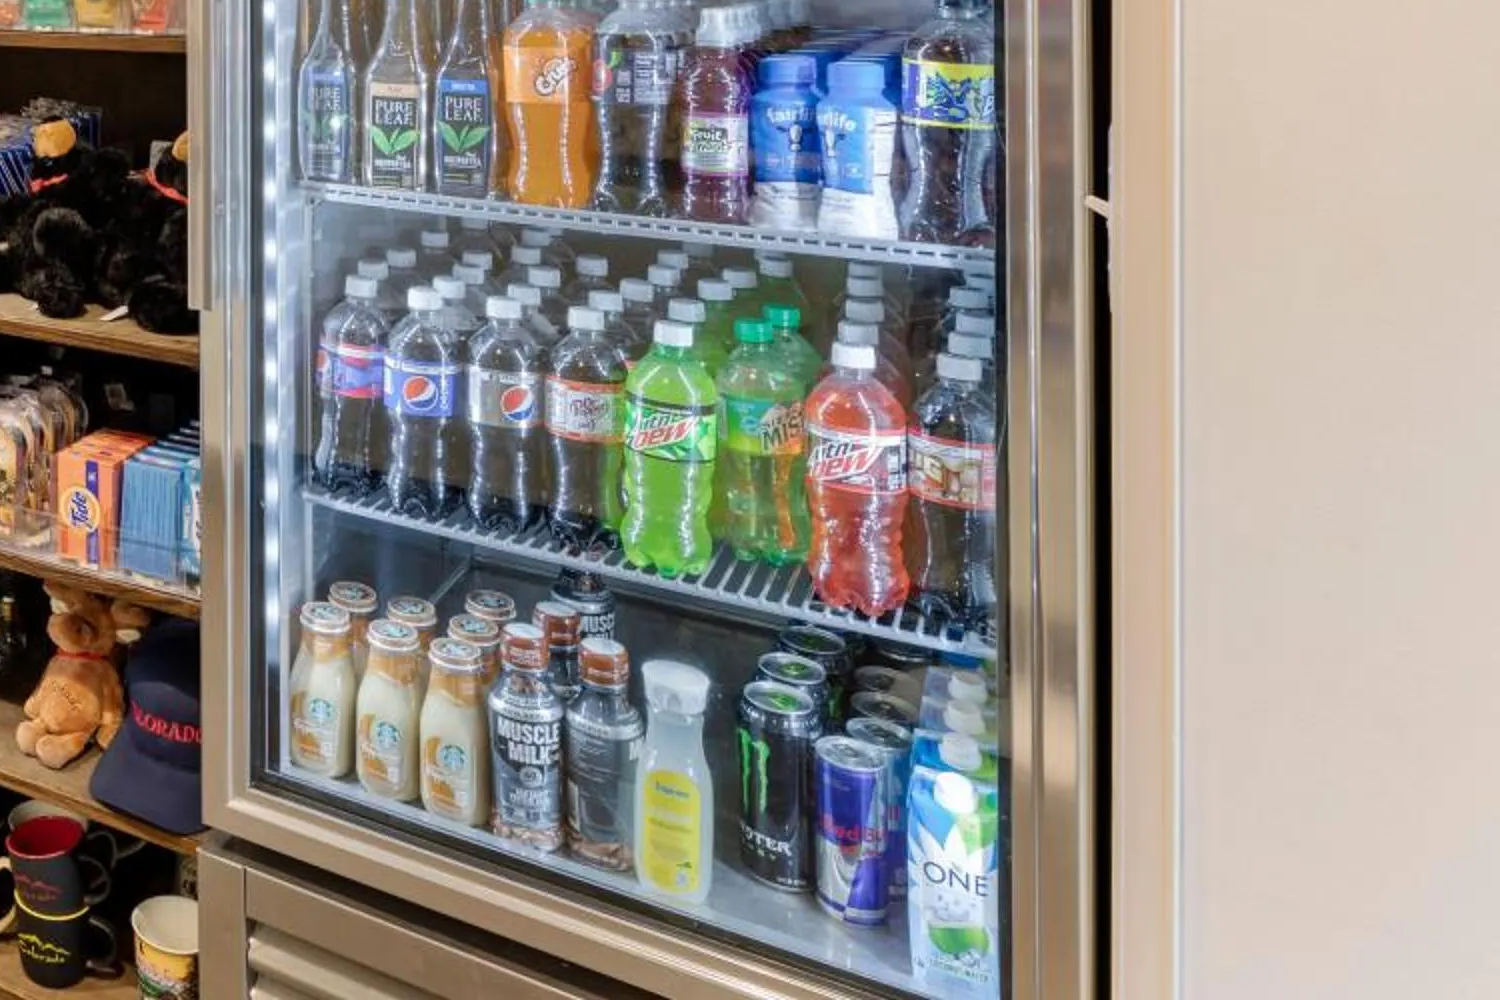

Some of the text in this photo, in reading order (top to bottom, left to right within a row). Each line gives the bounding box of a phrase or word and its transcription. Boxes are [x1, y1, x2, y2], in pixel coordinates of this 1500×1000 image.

[375, 100, 414, 113] PURE
[445, 96, 484, 109] PURE
[375, 112, 414, 126] LEAF
[445, 109, 484, 122] LEAF
[691, 128, 723, 142] Fruit
[70, 491, 90, 528] Tide
[498, 715, 560, 745] MUSCLE
[507, 741, 555, 765] MILK
[923, 861, 989, 897] ONE
